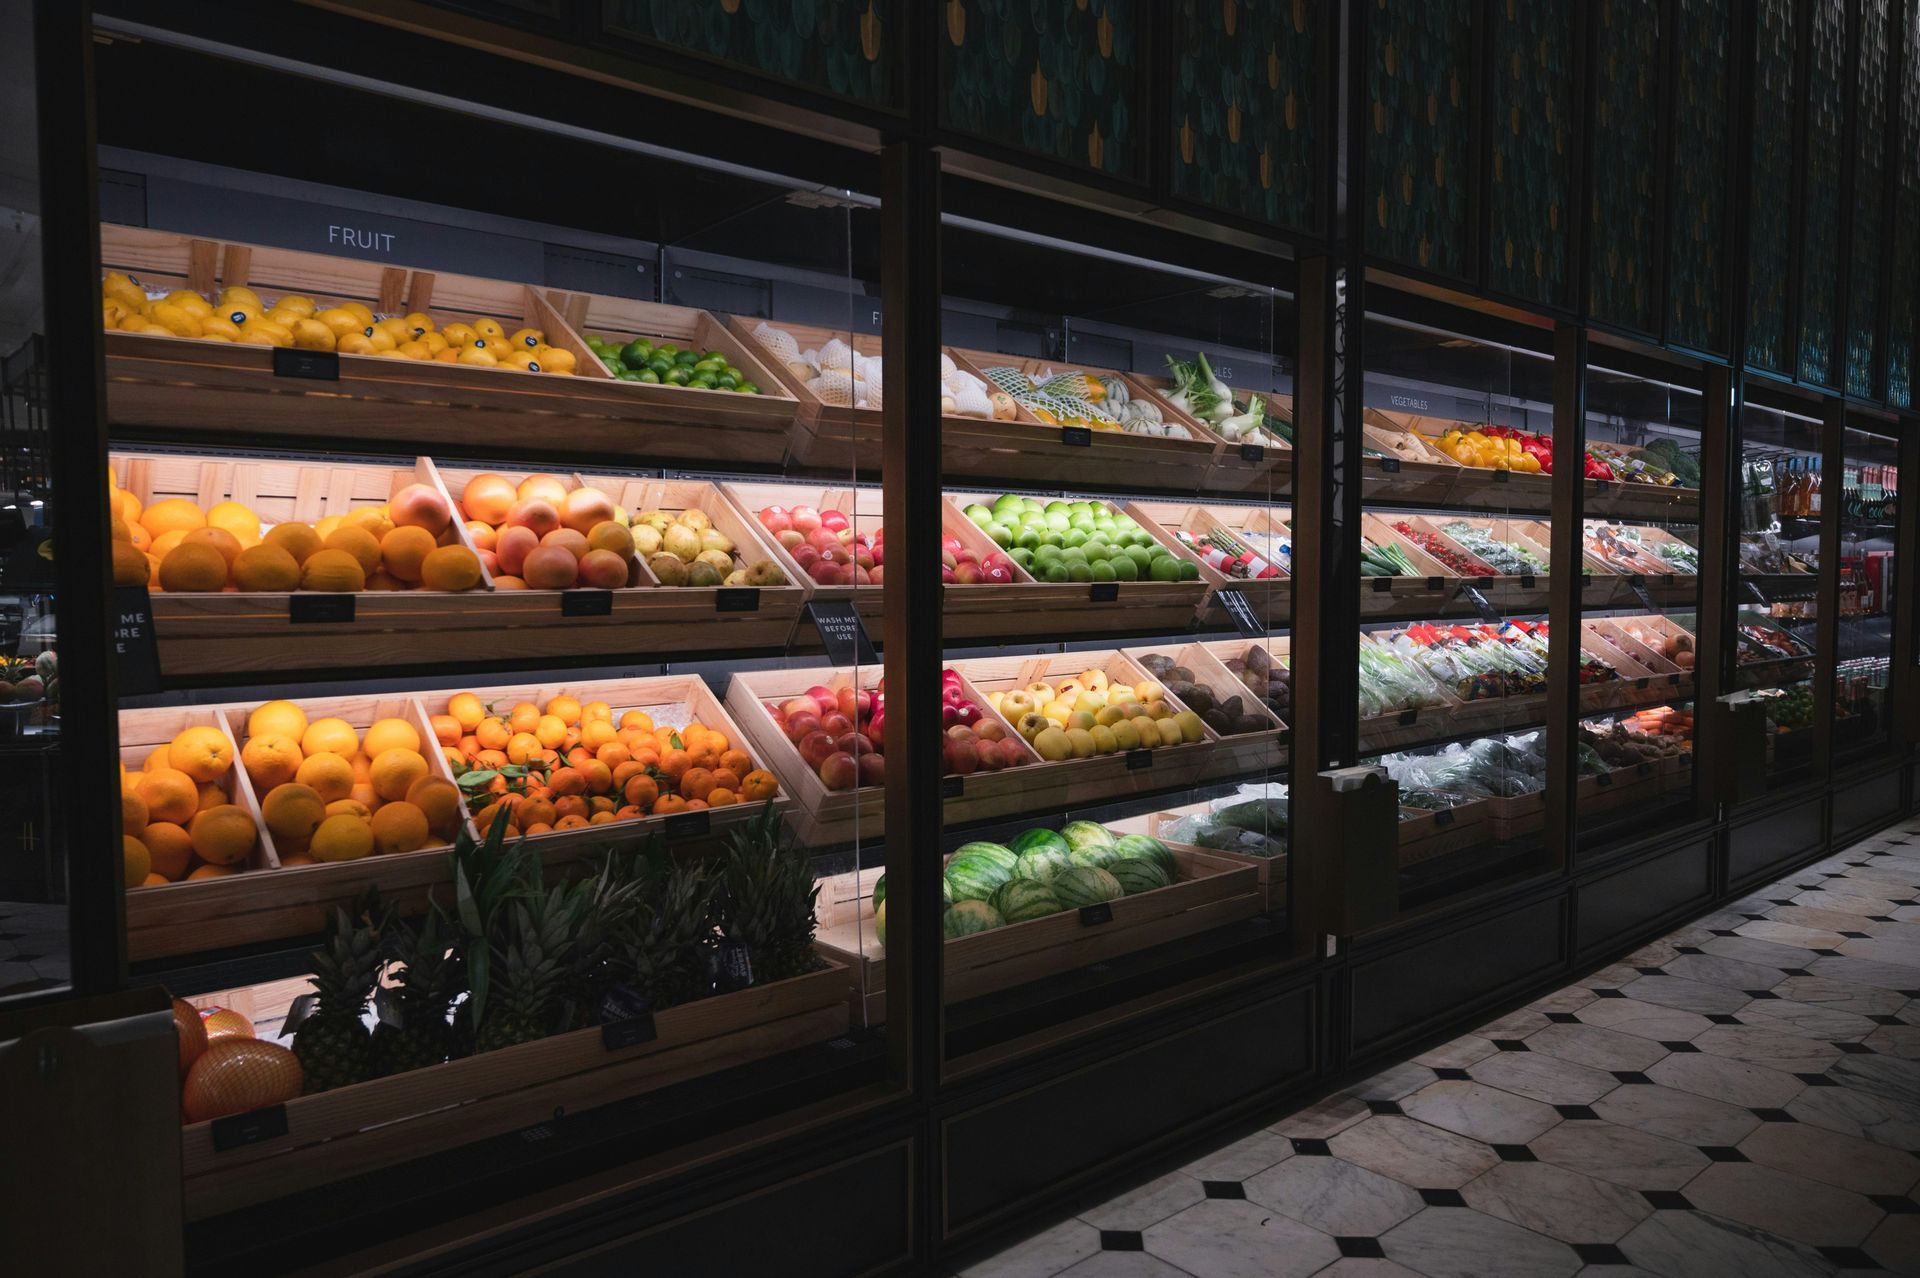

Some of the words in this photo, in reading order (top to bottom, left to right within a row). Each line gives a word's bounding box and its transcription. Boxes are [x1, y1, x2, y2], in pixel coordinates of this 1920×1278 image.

[328, 225, 396, 253] FRUIT
[1390, 394, 1428, 410] VEGETABLES
[120, 612, 145, 624] ME
[816, 616, 842, 624] WASH
[843, 616, 856, 624] ME
[824, 625, 856, 633] BEFORE
[836, 633, 853, 641] USE
